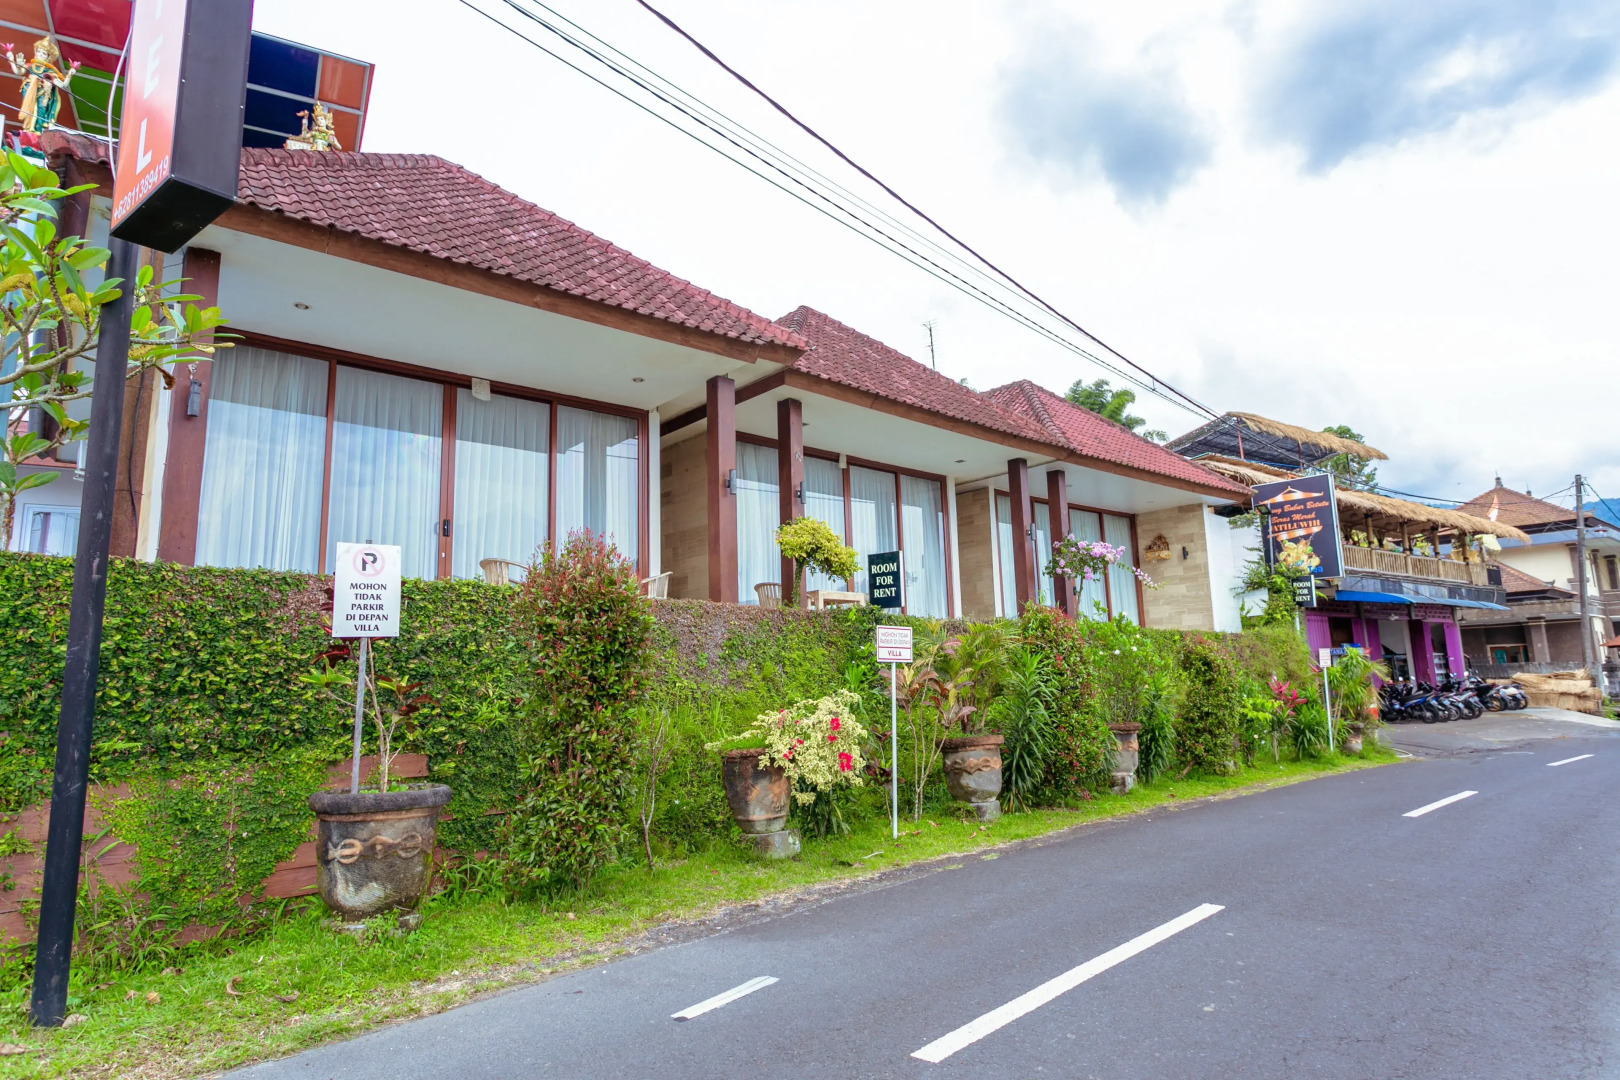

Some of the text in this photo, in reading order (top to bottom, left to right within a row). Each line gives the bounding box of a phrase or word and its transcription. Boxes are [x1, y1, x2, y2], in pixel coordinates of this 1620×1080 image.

[113, 155, 169, 220] +62811389419
[1283, 504, 1305, 512] Bubur
[1306, 500, 1330, 509] Betutu
[1291, 511, 1316, 521] Merah
[871, 562, 898, 574] ROOM
[1307, 565, 1323, 573] Tea
[875, 575, 894, 586] FOR
[349, 582, 387, 591] MOHON
[353, 592, 383, 601] TIDAK
[873, 587, 897, 599] RENT
[350, 603, 384, 611] PARKIR
[345, 613, 389, 621] DI DEPAN
[353, 624, 380, 632] VILLA
